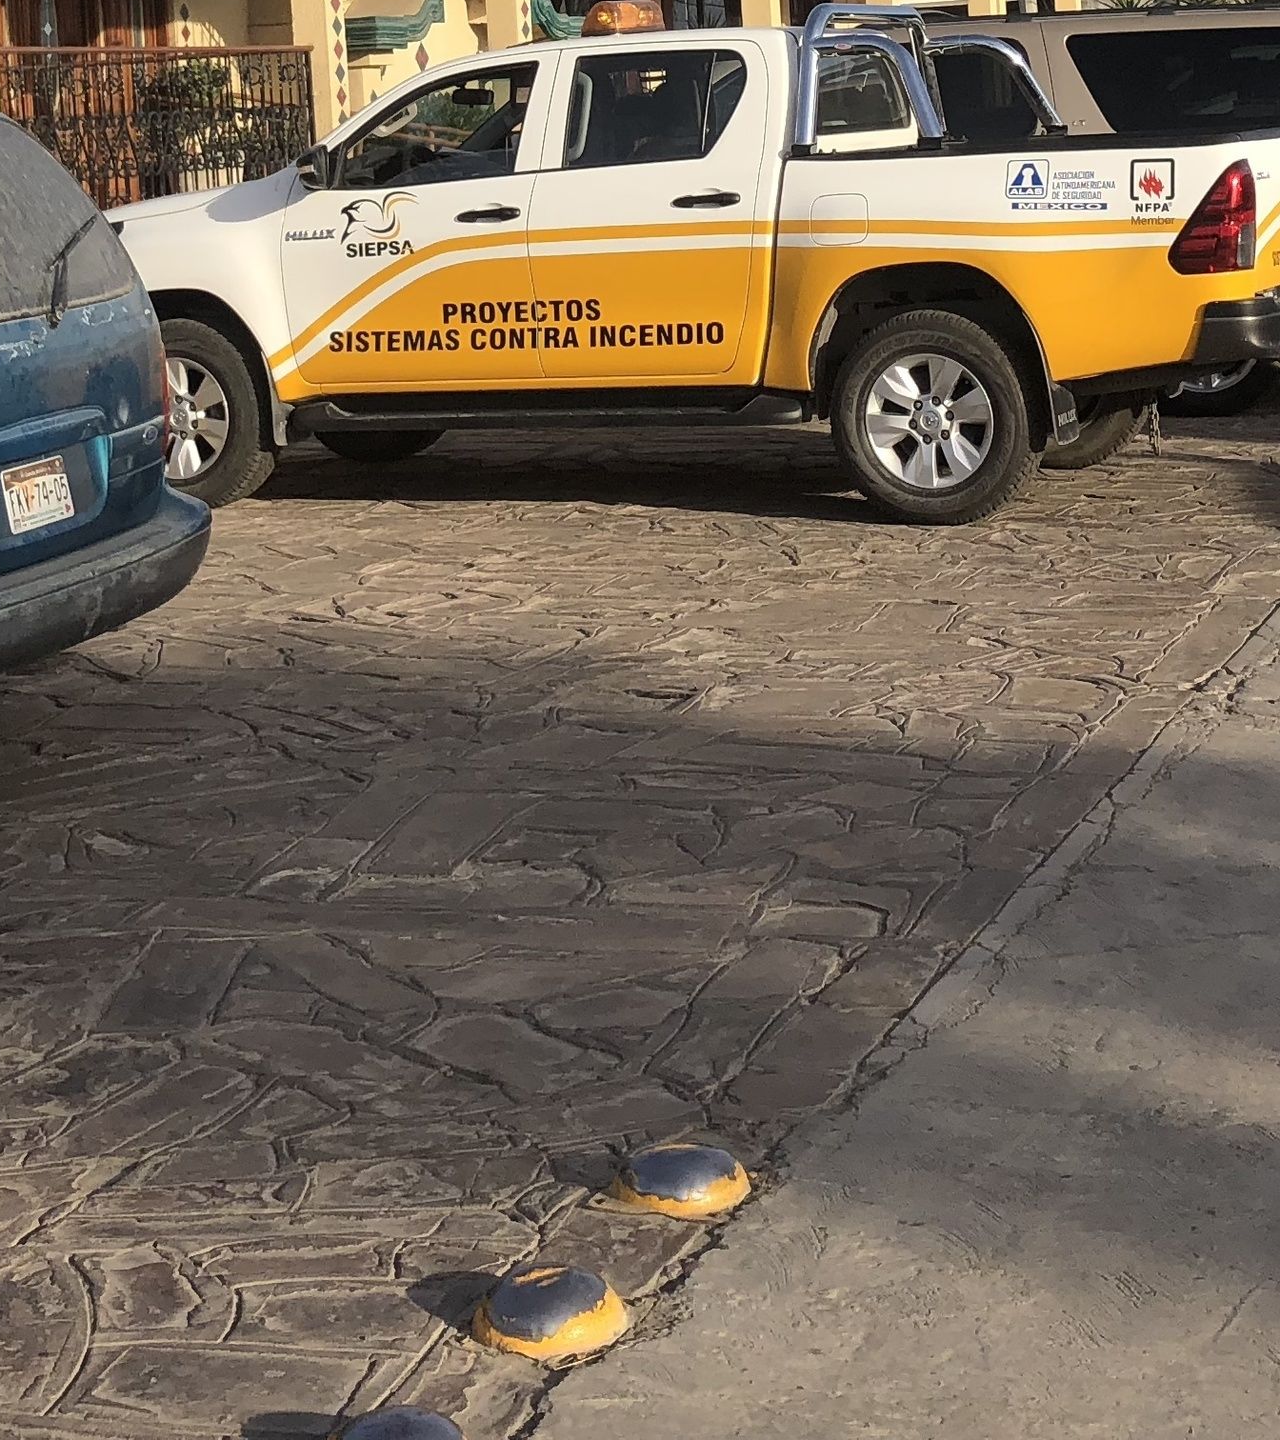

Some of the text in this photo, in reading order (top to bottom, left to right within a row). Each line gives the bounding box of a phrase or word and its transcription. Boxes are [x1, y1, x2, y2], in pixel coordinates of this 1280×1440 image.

[1052, 181, 1116, 190] LATINOAMERICANA
[1052, 191, 1102, 200] DE SEGURIDAD
[1017, 202, 1103, 210] MEXICO
[1135, 203, 1170, 213] NFPA
[1131, 215, 1175, 226] Member
[346, 240, 415, 259] SIEPSA
[442, 298, 601, 325] PROYECTOS
[328, 321, 724, 353] SISTEMAS CONTRA INCENDIO
